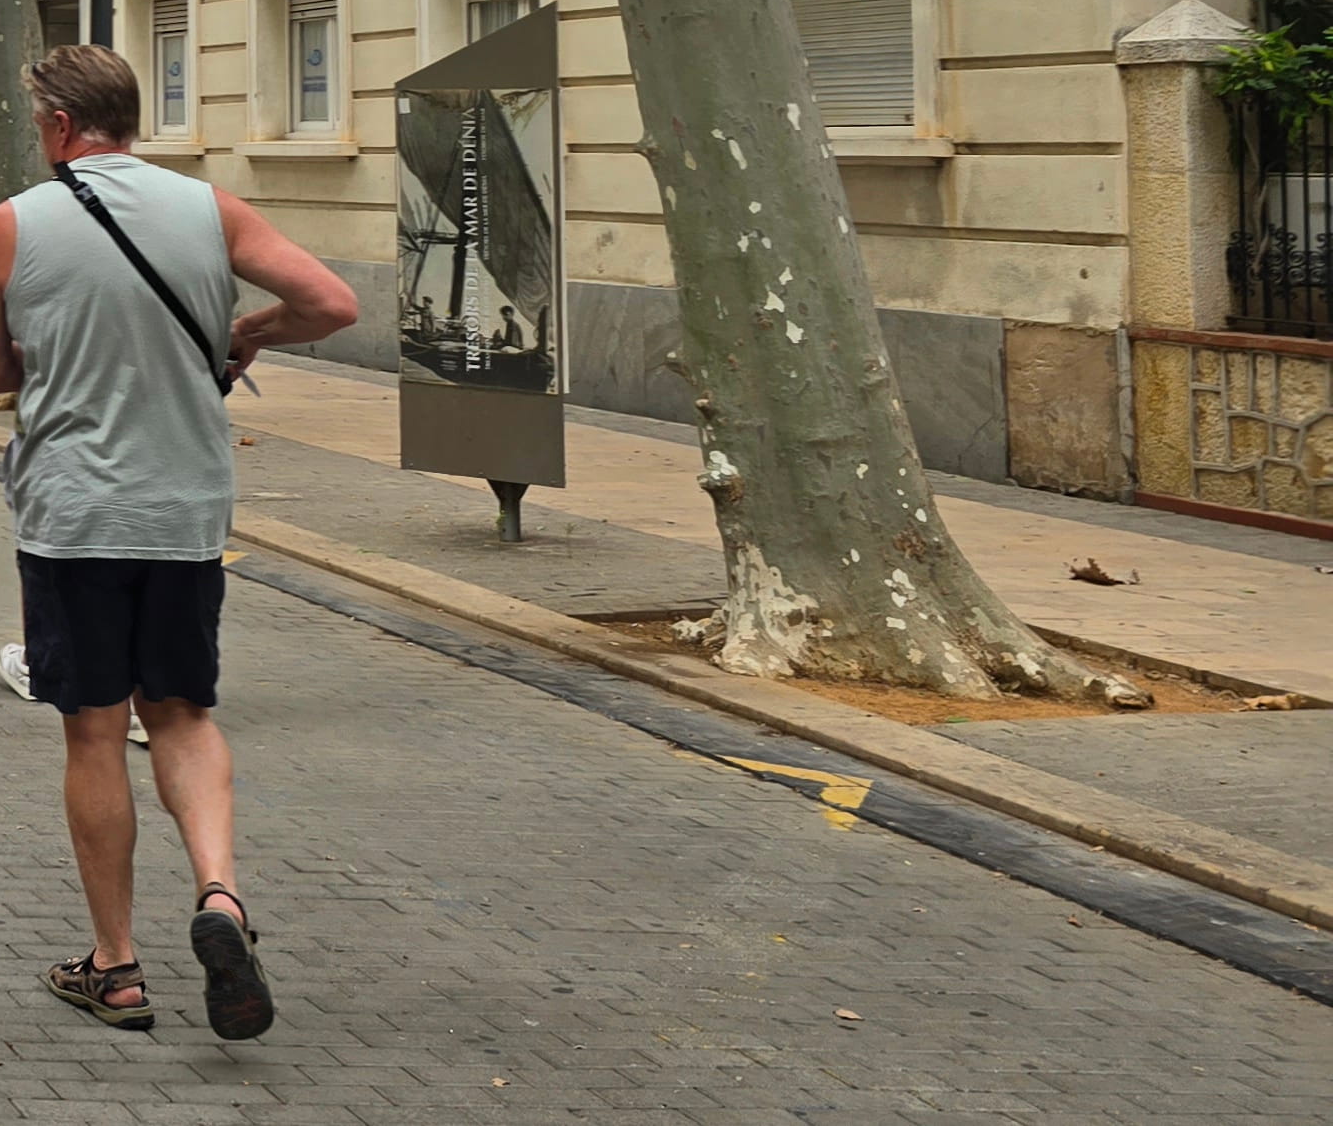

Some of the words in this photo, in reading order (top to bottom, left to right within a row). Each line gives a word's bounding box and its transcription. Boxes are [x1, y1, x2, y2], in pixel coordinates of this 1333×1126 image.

[462, 168, 478, 191] DE
[463, 197, 479, 236] MAR
[464, 240, 479, 262] LA
[465, 268, 480, 292] DE
[465, 296, 482, 372] TRESORS
